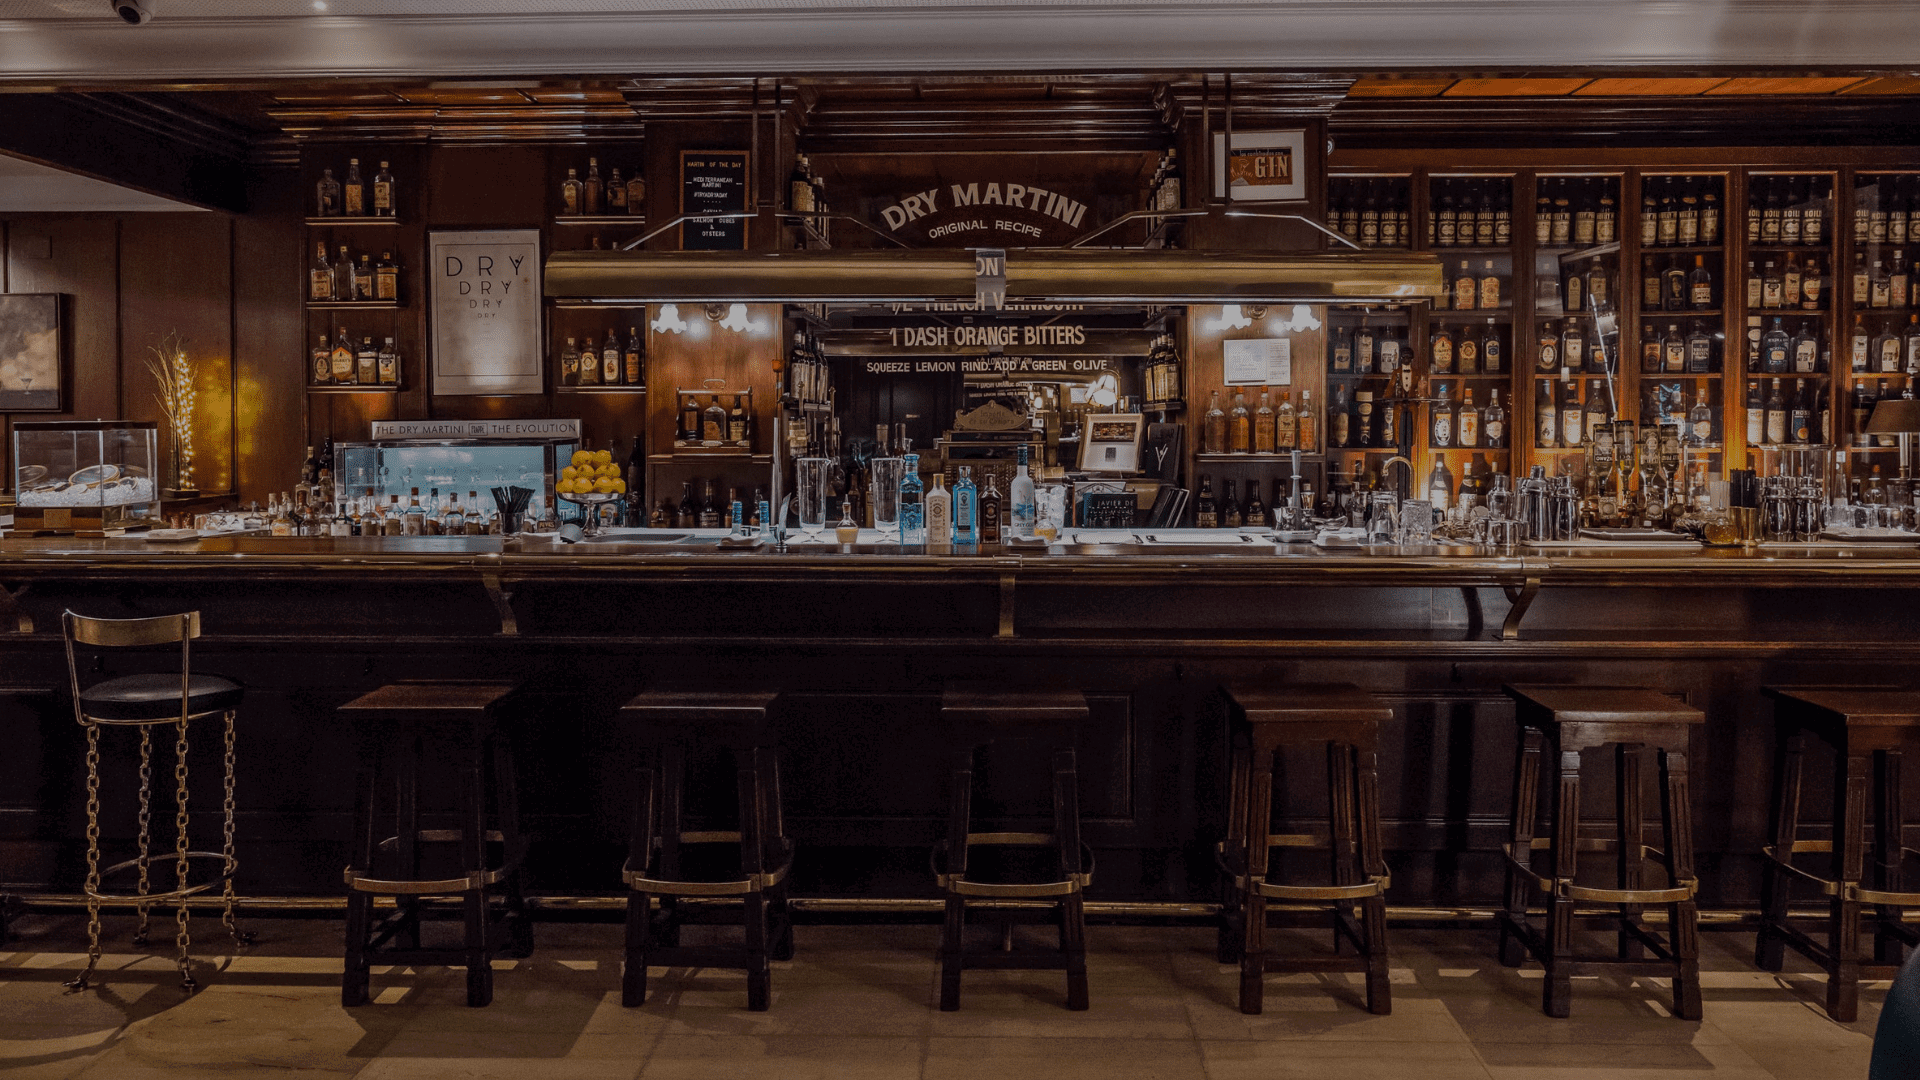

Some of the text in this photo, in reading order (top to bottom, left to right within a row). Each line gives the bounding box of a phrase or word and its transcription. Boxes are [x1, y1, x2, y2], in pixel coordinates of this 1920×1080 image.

[881, 182, 1088, 232] DRY MARTINI
[928, 220, 1042, 238] ORIGINAL RECIPE
[446, 254, 524, 277] DRY
[460, 280, 512, 295] DRY
[470, 299, 502, 309] DRY
[889, 325, 1086, 346] 1 DASH ORANGE BITTERS
[866, 359, 1108, 374] SQUEEZE LEMON RIND. ADD A GREEN OLIVE
[376, 426, 394, 434] THE
[399, 425, 419, 434] DRY
[422, 425, 464, 434] MARTINI
[493, 425, 511, 433] THE
[515, 424, 576, 433] EVOLUTION
